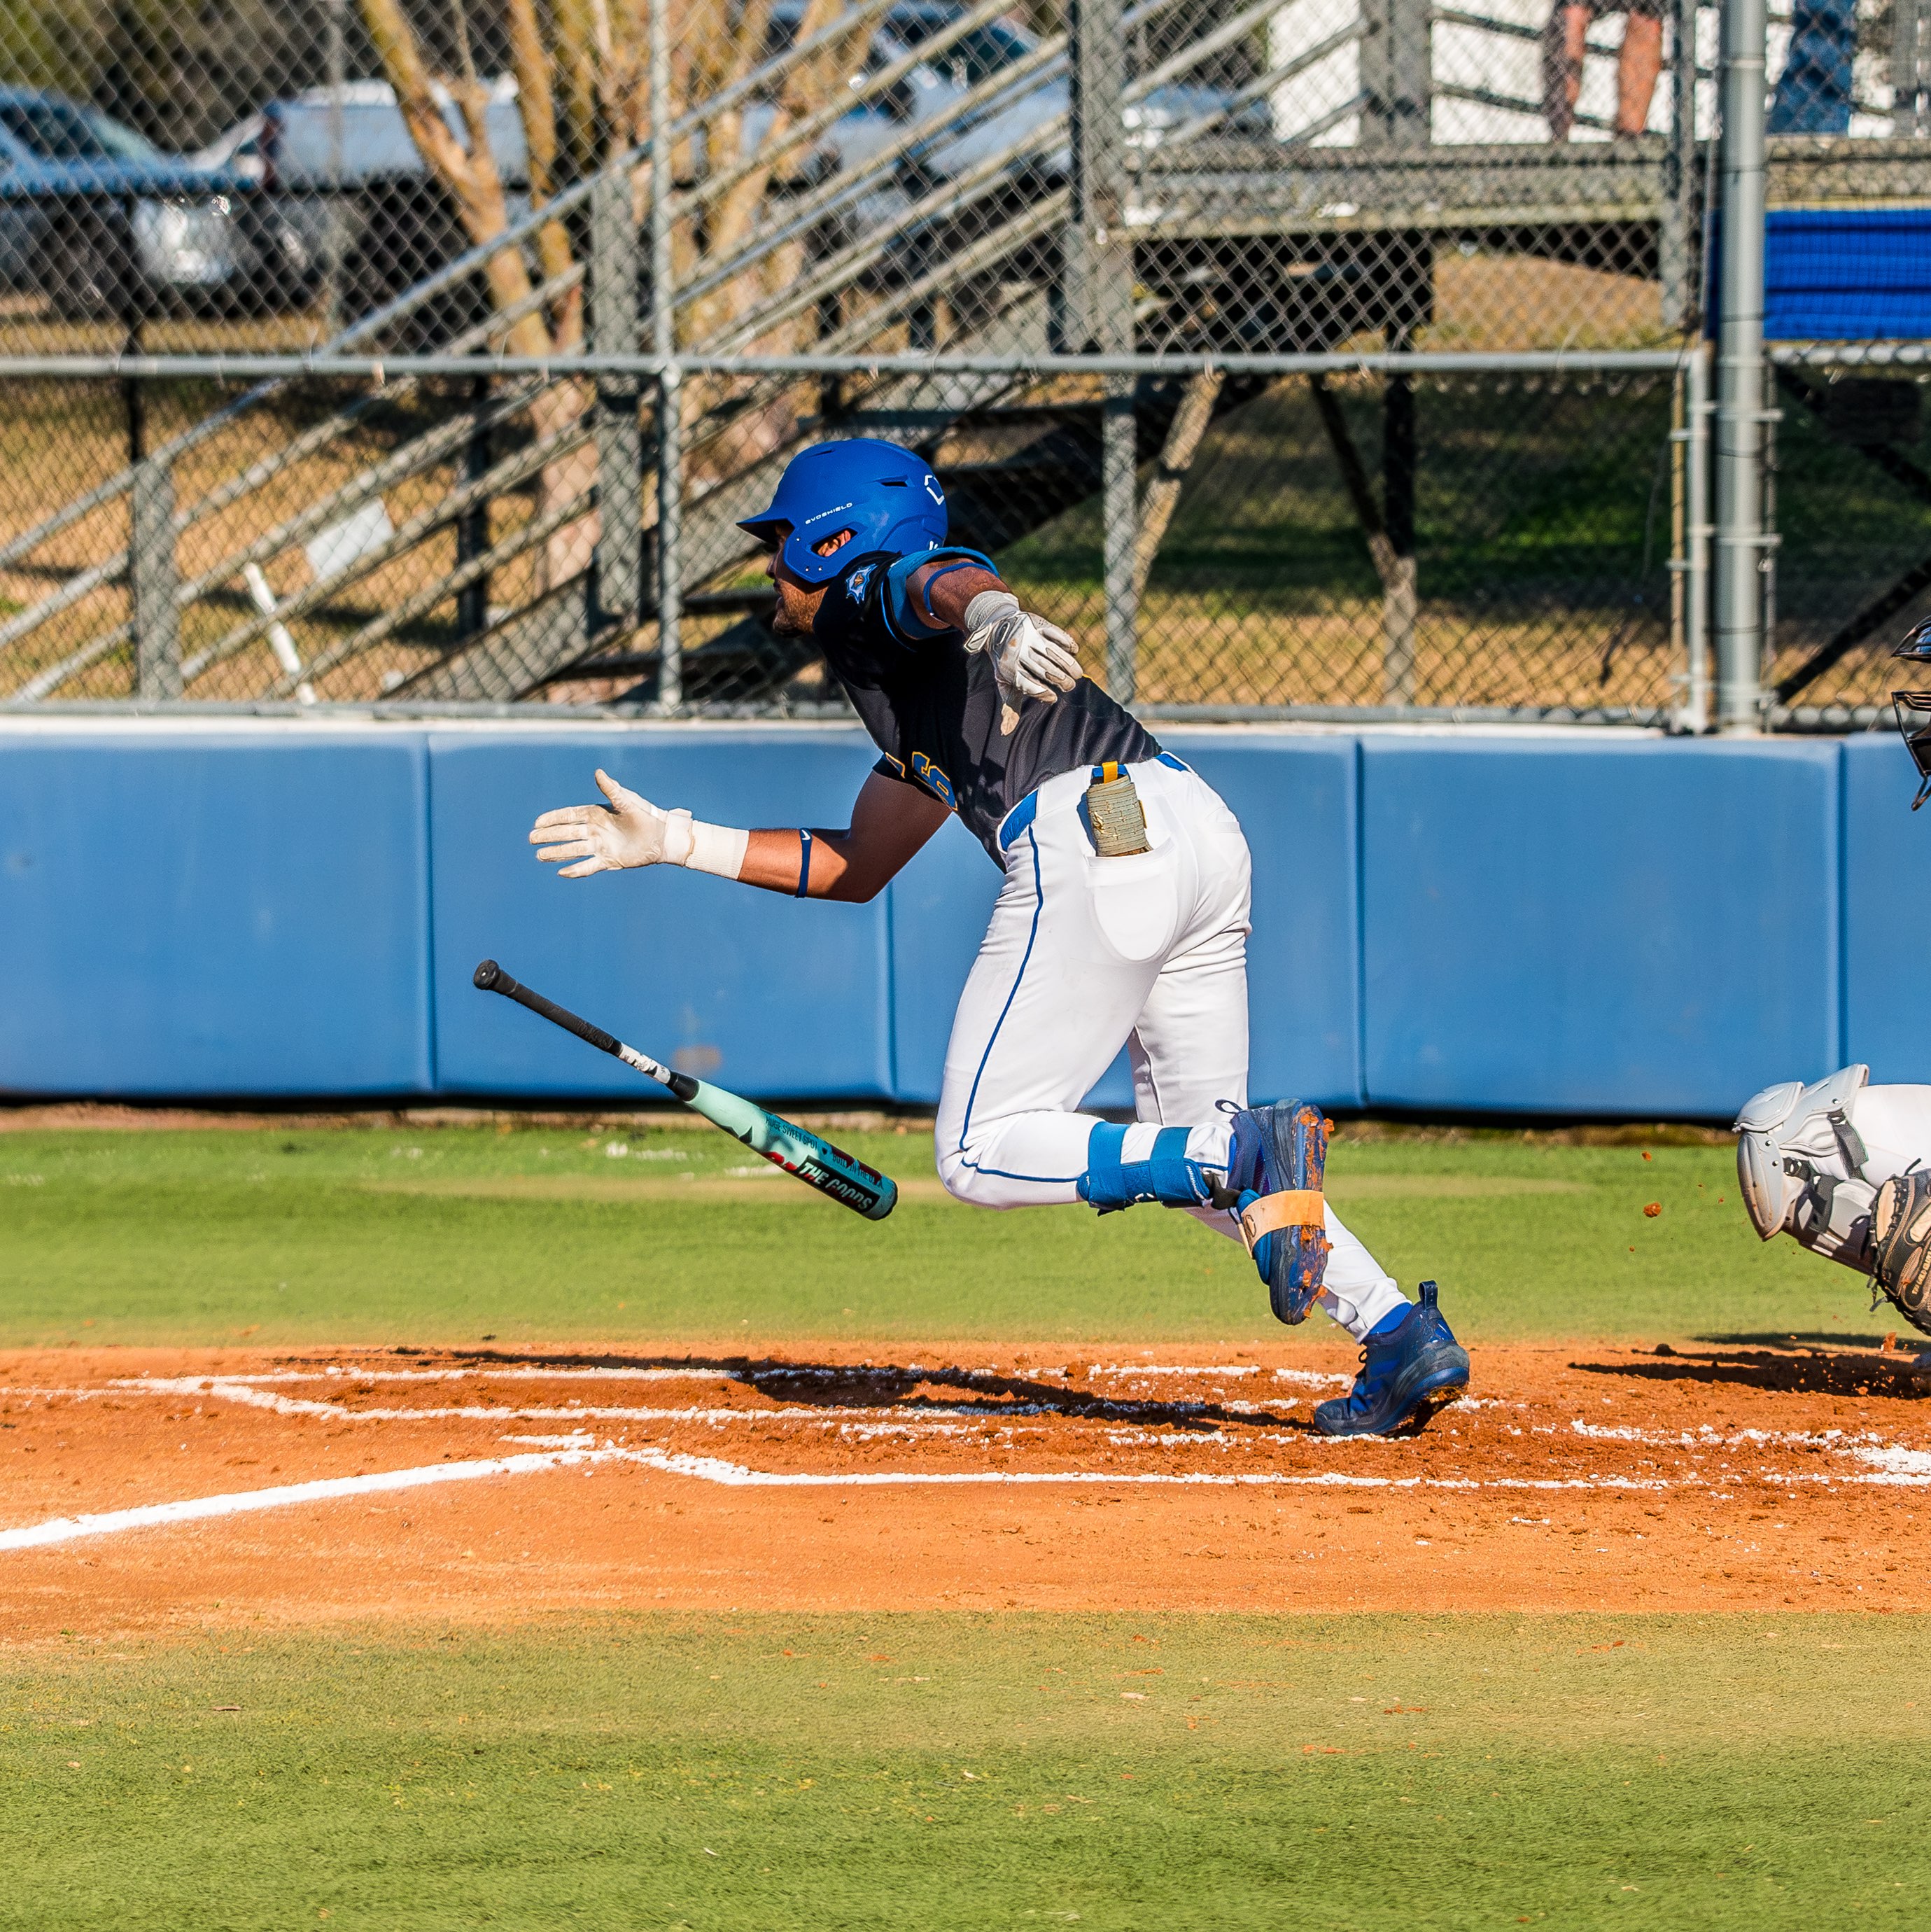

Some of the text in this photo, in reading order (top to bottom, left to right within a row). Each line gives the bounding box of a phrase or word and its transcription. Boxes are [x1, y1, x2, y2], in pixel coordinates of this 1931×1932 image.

[805, 502, 853, 524] EVOSHIELD
[799, 1161, 873, 1210] THE GOODS
